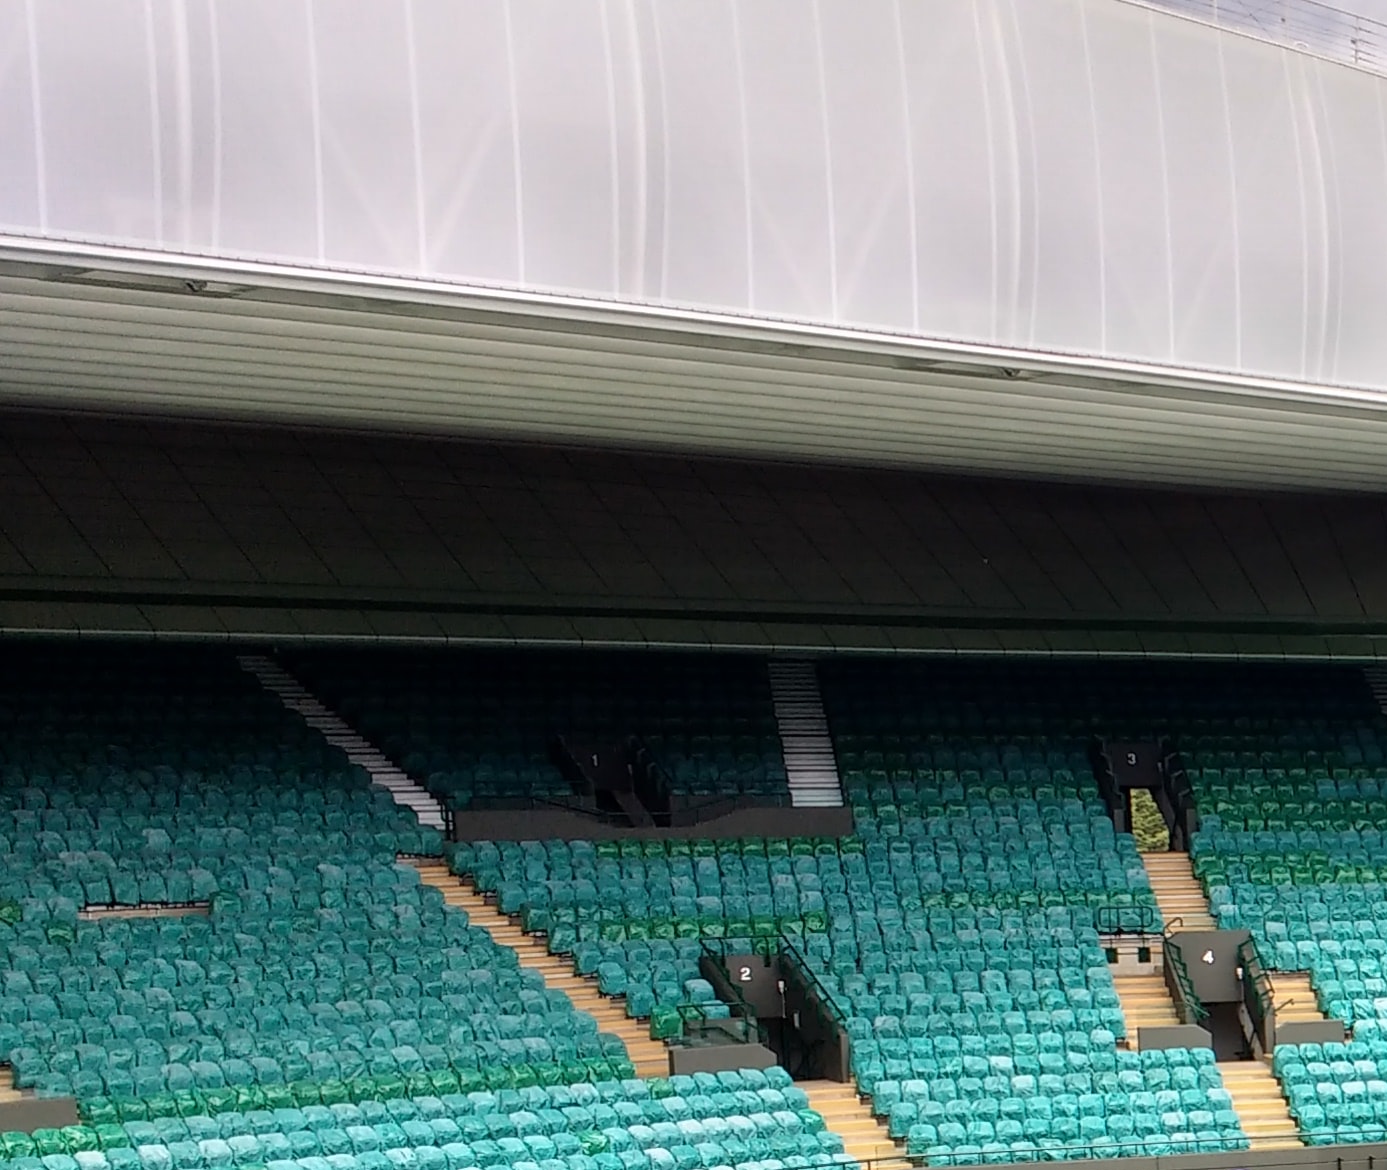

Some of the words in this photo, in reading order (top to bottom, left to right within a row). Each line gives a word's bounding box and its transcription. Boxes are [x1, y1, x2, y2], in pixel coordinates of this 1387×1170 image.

[592, 754, 599, 767] 1
[1127, 752, 1137, 766] 3
[1202, 950, 1214, 964] 4
[740, 967, 751, 981] 2
